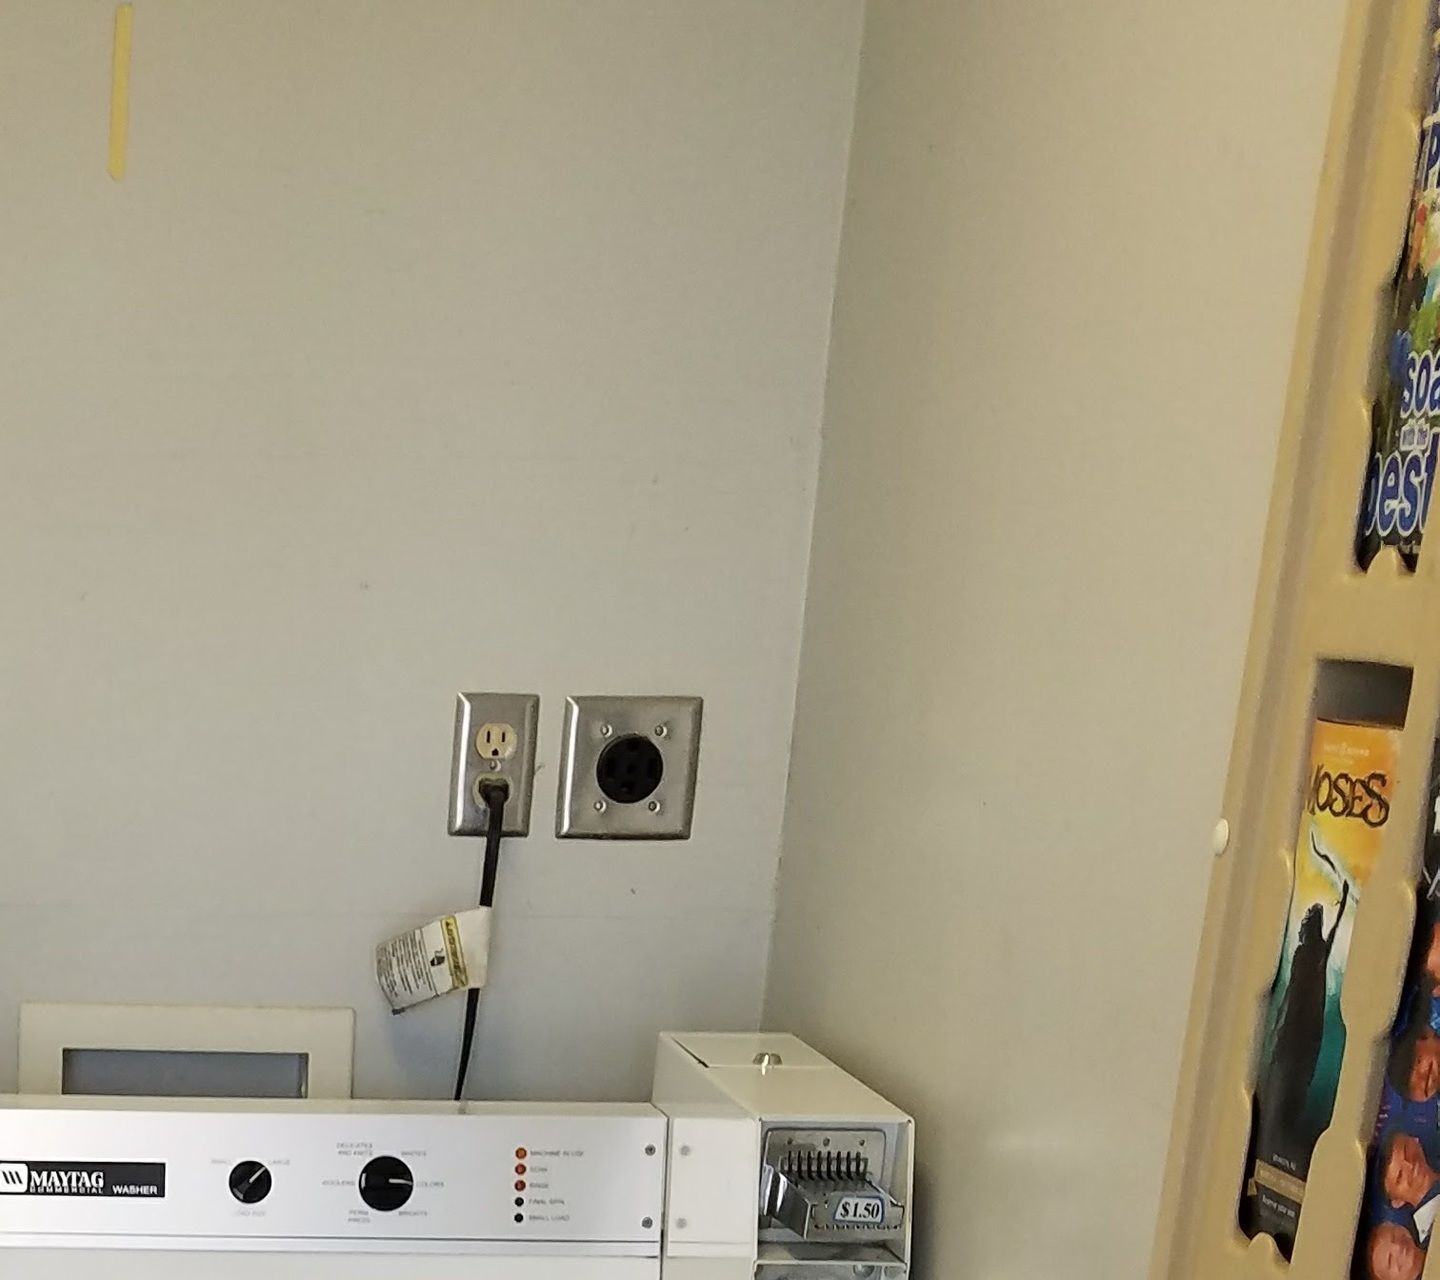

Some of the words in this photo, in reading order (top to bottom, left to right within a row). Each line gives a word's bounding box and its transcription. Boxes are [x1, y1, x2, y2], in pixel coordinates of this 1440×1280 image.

[29, 1171, 105, 1187] MAYTAG
[112, 1185, 158, 1195] WASHER
[840, 1200, 881, 1220] $1.50
